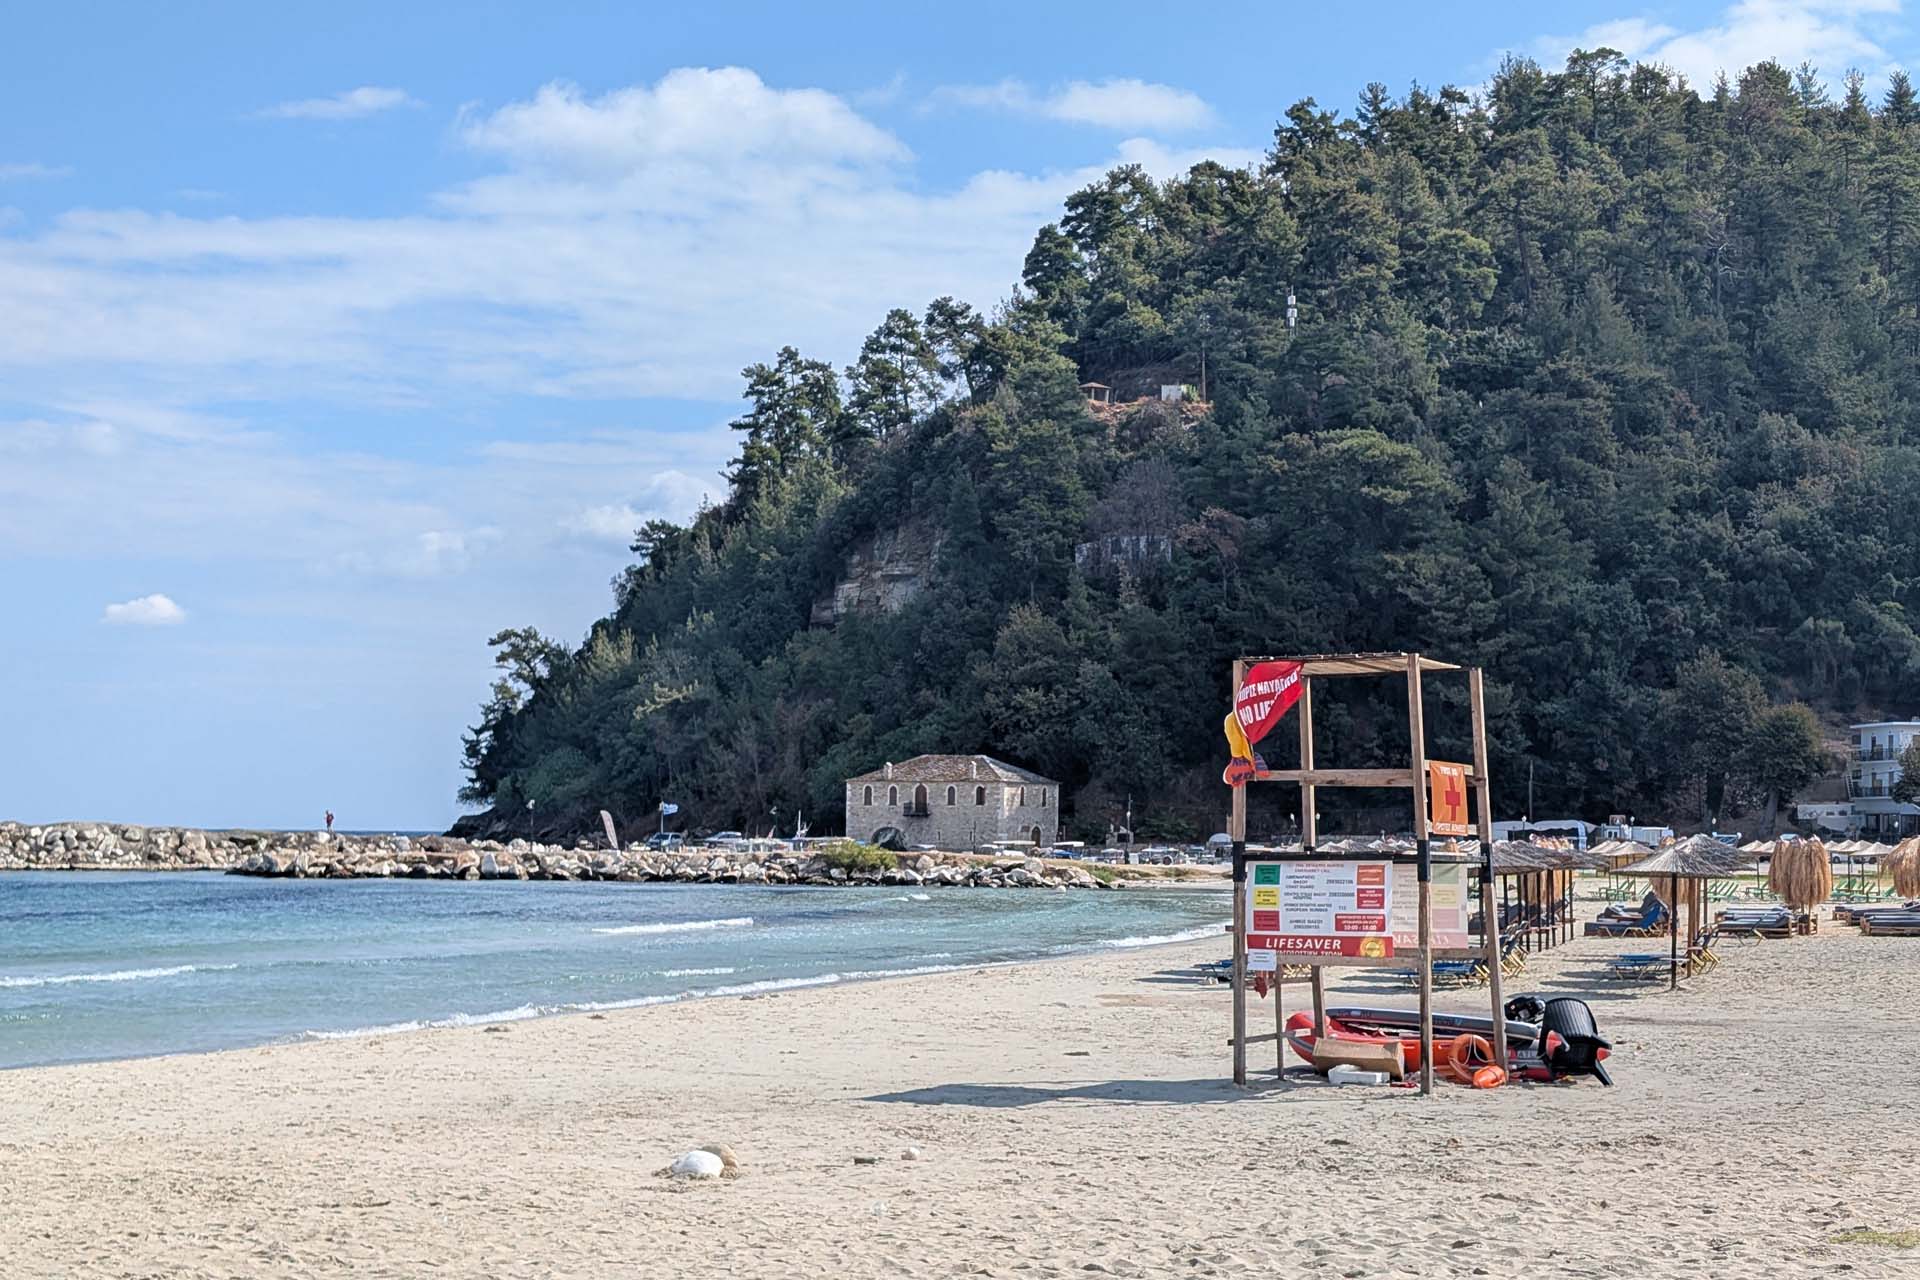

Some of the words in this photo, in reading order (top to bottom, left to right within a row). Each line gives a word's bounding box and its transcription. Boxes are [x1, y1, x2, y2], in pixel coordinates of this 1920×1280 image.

[1239, 705, 1253, 726] NO
[1253, 700, 1275, 721] LIF
[1265, 937, 1342, 950] LIFESAVER
